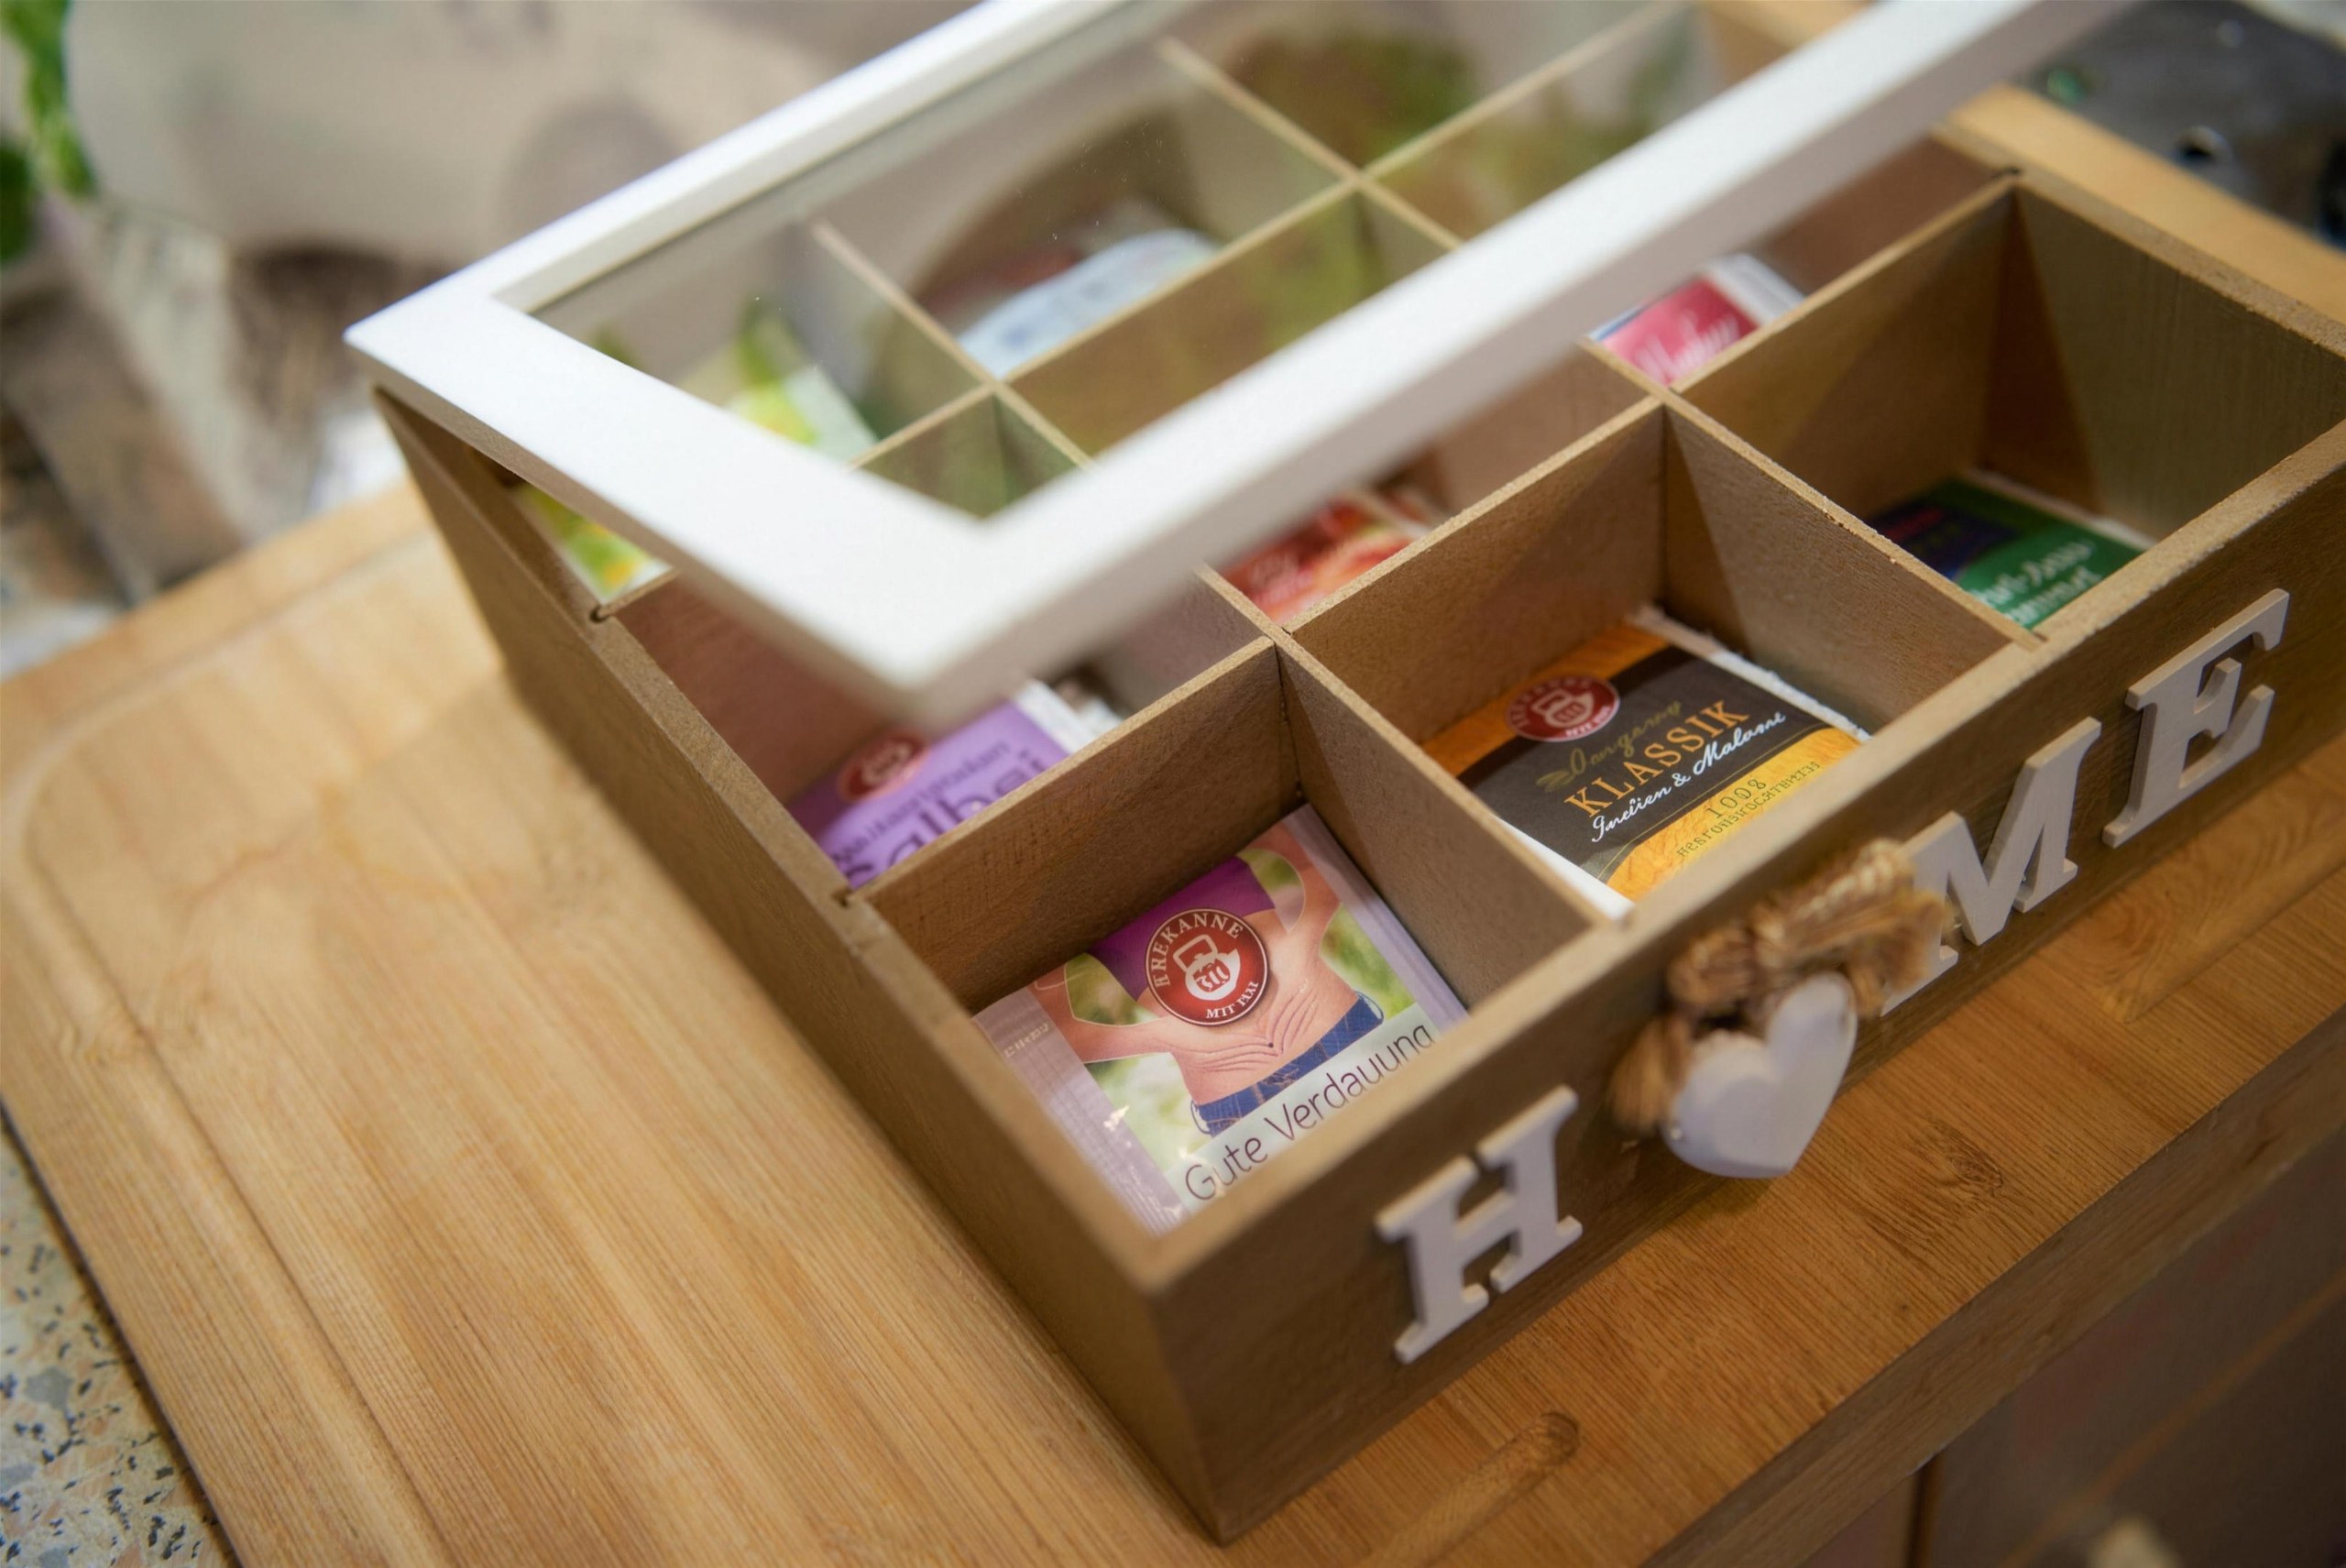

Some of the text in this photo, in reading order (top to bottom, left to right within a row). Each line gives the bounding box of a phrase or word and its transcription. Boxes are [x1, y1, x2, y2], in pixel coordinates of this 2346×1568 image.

[1564, 700, 1749, 818] KLASSIK
[1673, 772, 1691, 788] &
[1184, 1022, 1437, 1201] Gute Verdauung
